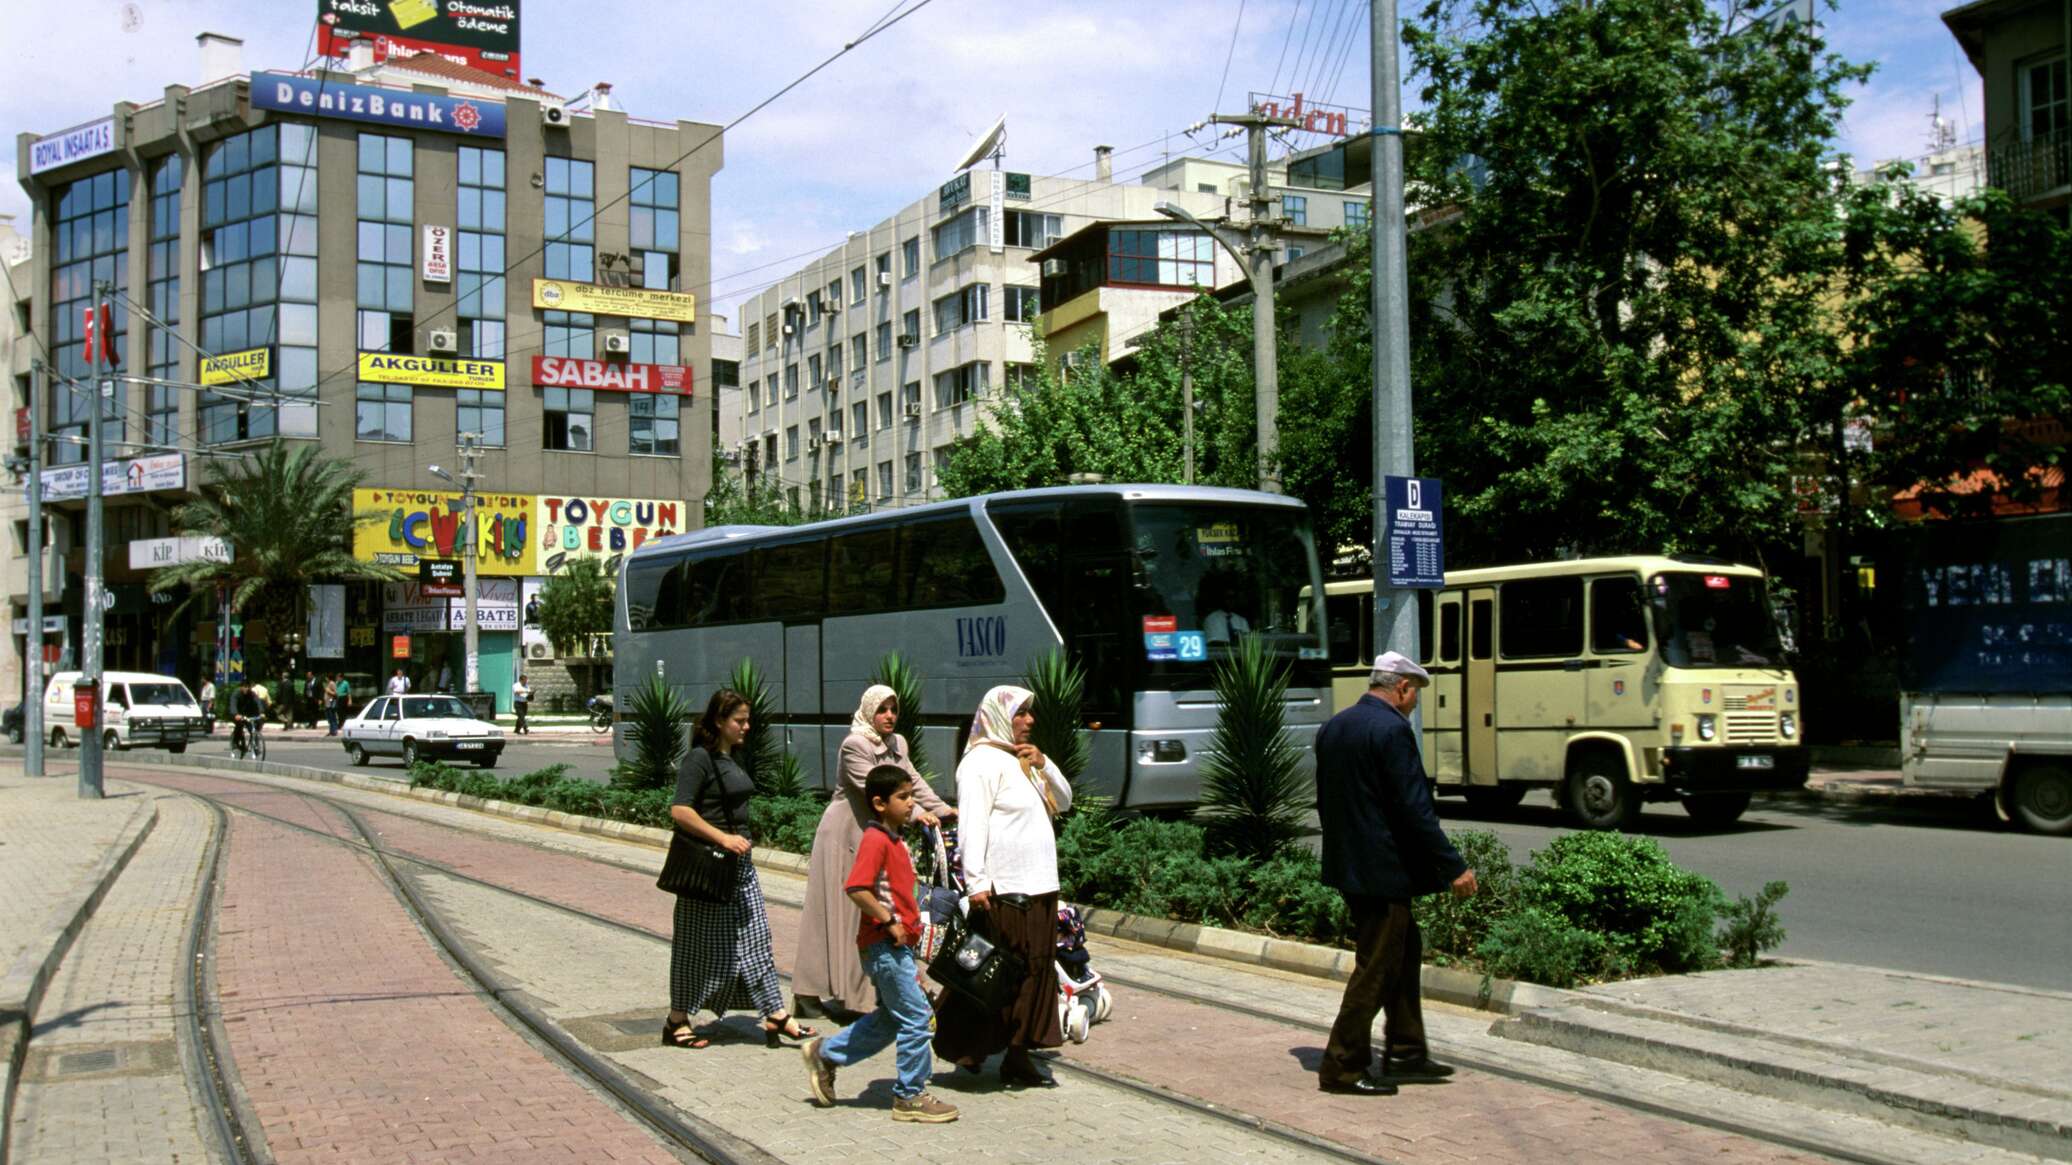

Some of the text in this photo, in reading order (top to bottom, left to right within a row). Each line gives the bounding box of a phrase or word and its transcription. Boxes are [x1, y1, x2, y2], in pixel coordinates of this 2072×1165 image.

[331, 0, 381, 16] taksit
[448, 1, 515, 19] Otomatik
[457, 17, 508, 34] ödeme
[277, 83, 442, 123] DenizBank
[36, 141, 62, 166] ROYAL
[575, 286, 594, 295] dbz
[649, 293, 692, 304] merkezi
[540, 357, 649, 390] SABAH
[1411, 483, 1419, 506] D
[544, 498, 677, 528] TOYGUN
[957, 616, 1005, 656] VASCO
[1180, 635, 1202, 658] 29
